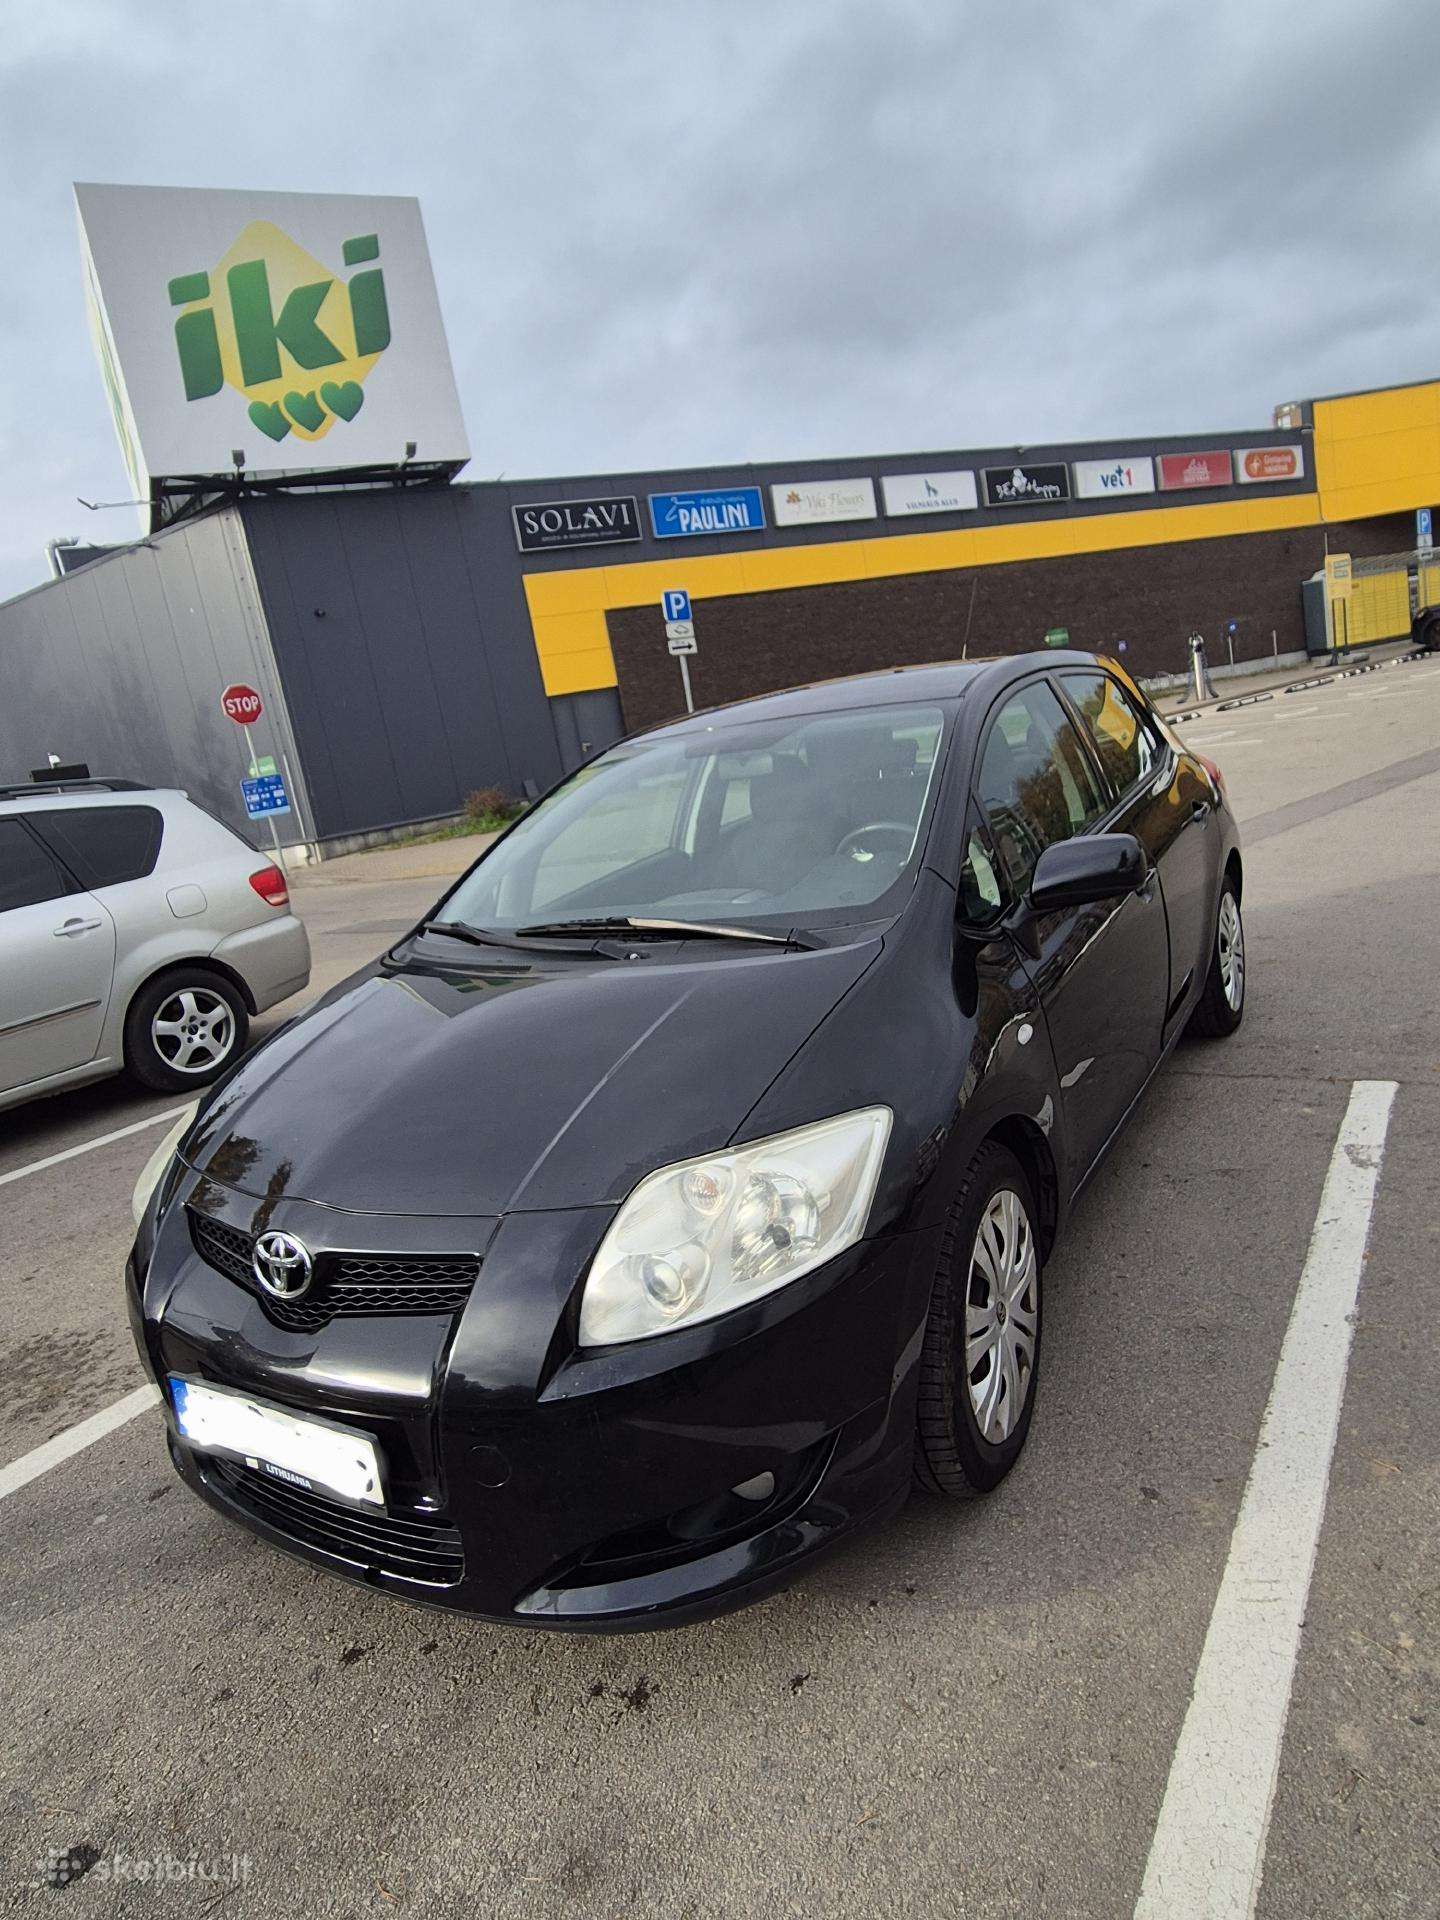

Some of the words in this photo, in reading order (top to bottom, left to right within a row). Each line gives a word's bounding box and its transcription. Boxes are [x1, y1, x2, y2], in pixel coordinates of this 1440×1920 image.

[168, 233, 391, 402] iki
[523, 503, 631, 534] SOLAVI
[678, 503, 750, 532] PAULINI
[669, 592, 686, 619] P
[225, 695, 259, 714] STOP
[265, 1463, 313, 1490] LITHUANIA
